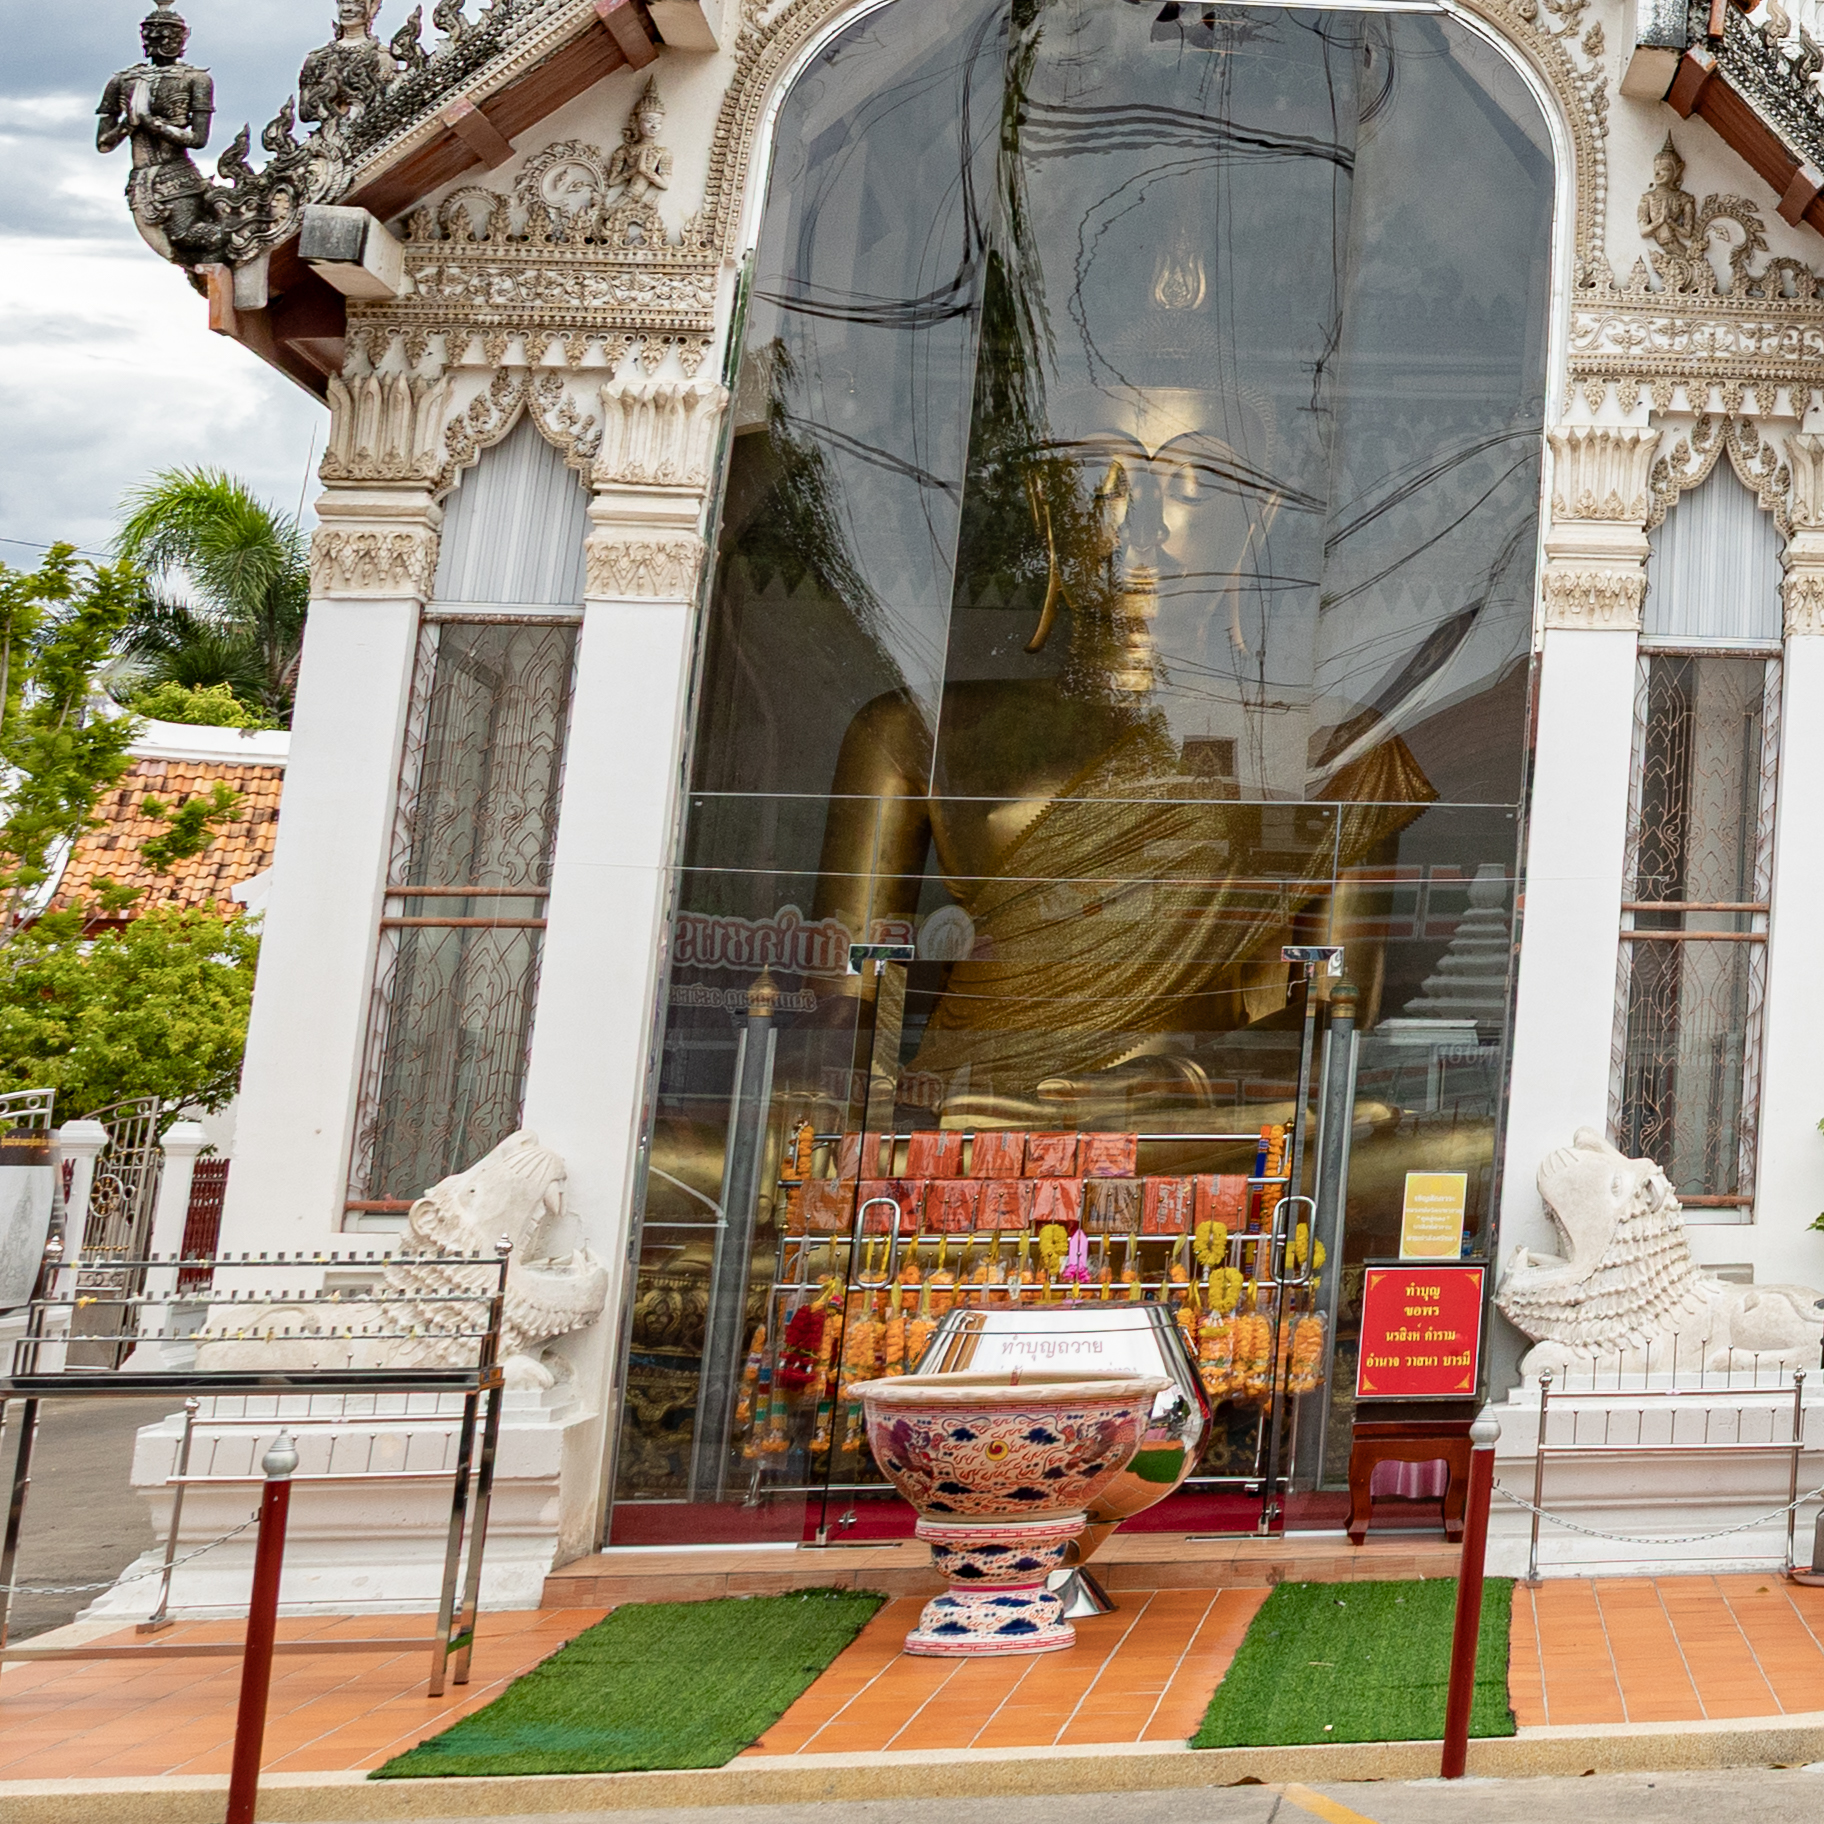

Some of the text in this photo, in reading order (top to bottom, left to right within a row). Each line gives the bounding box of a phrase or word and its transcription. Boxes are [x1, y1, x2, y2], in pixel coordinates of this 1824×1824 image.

[1405, 1282, 1440, 1301] ทำบุญ
[1404, 1305, 1440, 1317] ขอพร
[1424, 1326, 1456, 1342] คำราม
[1001, 1335, 1103, 1361] ทำบุญถวาย
[1366, 1350, 1471, 1368] อำนาจ วาสนา บารมี
